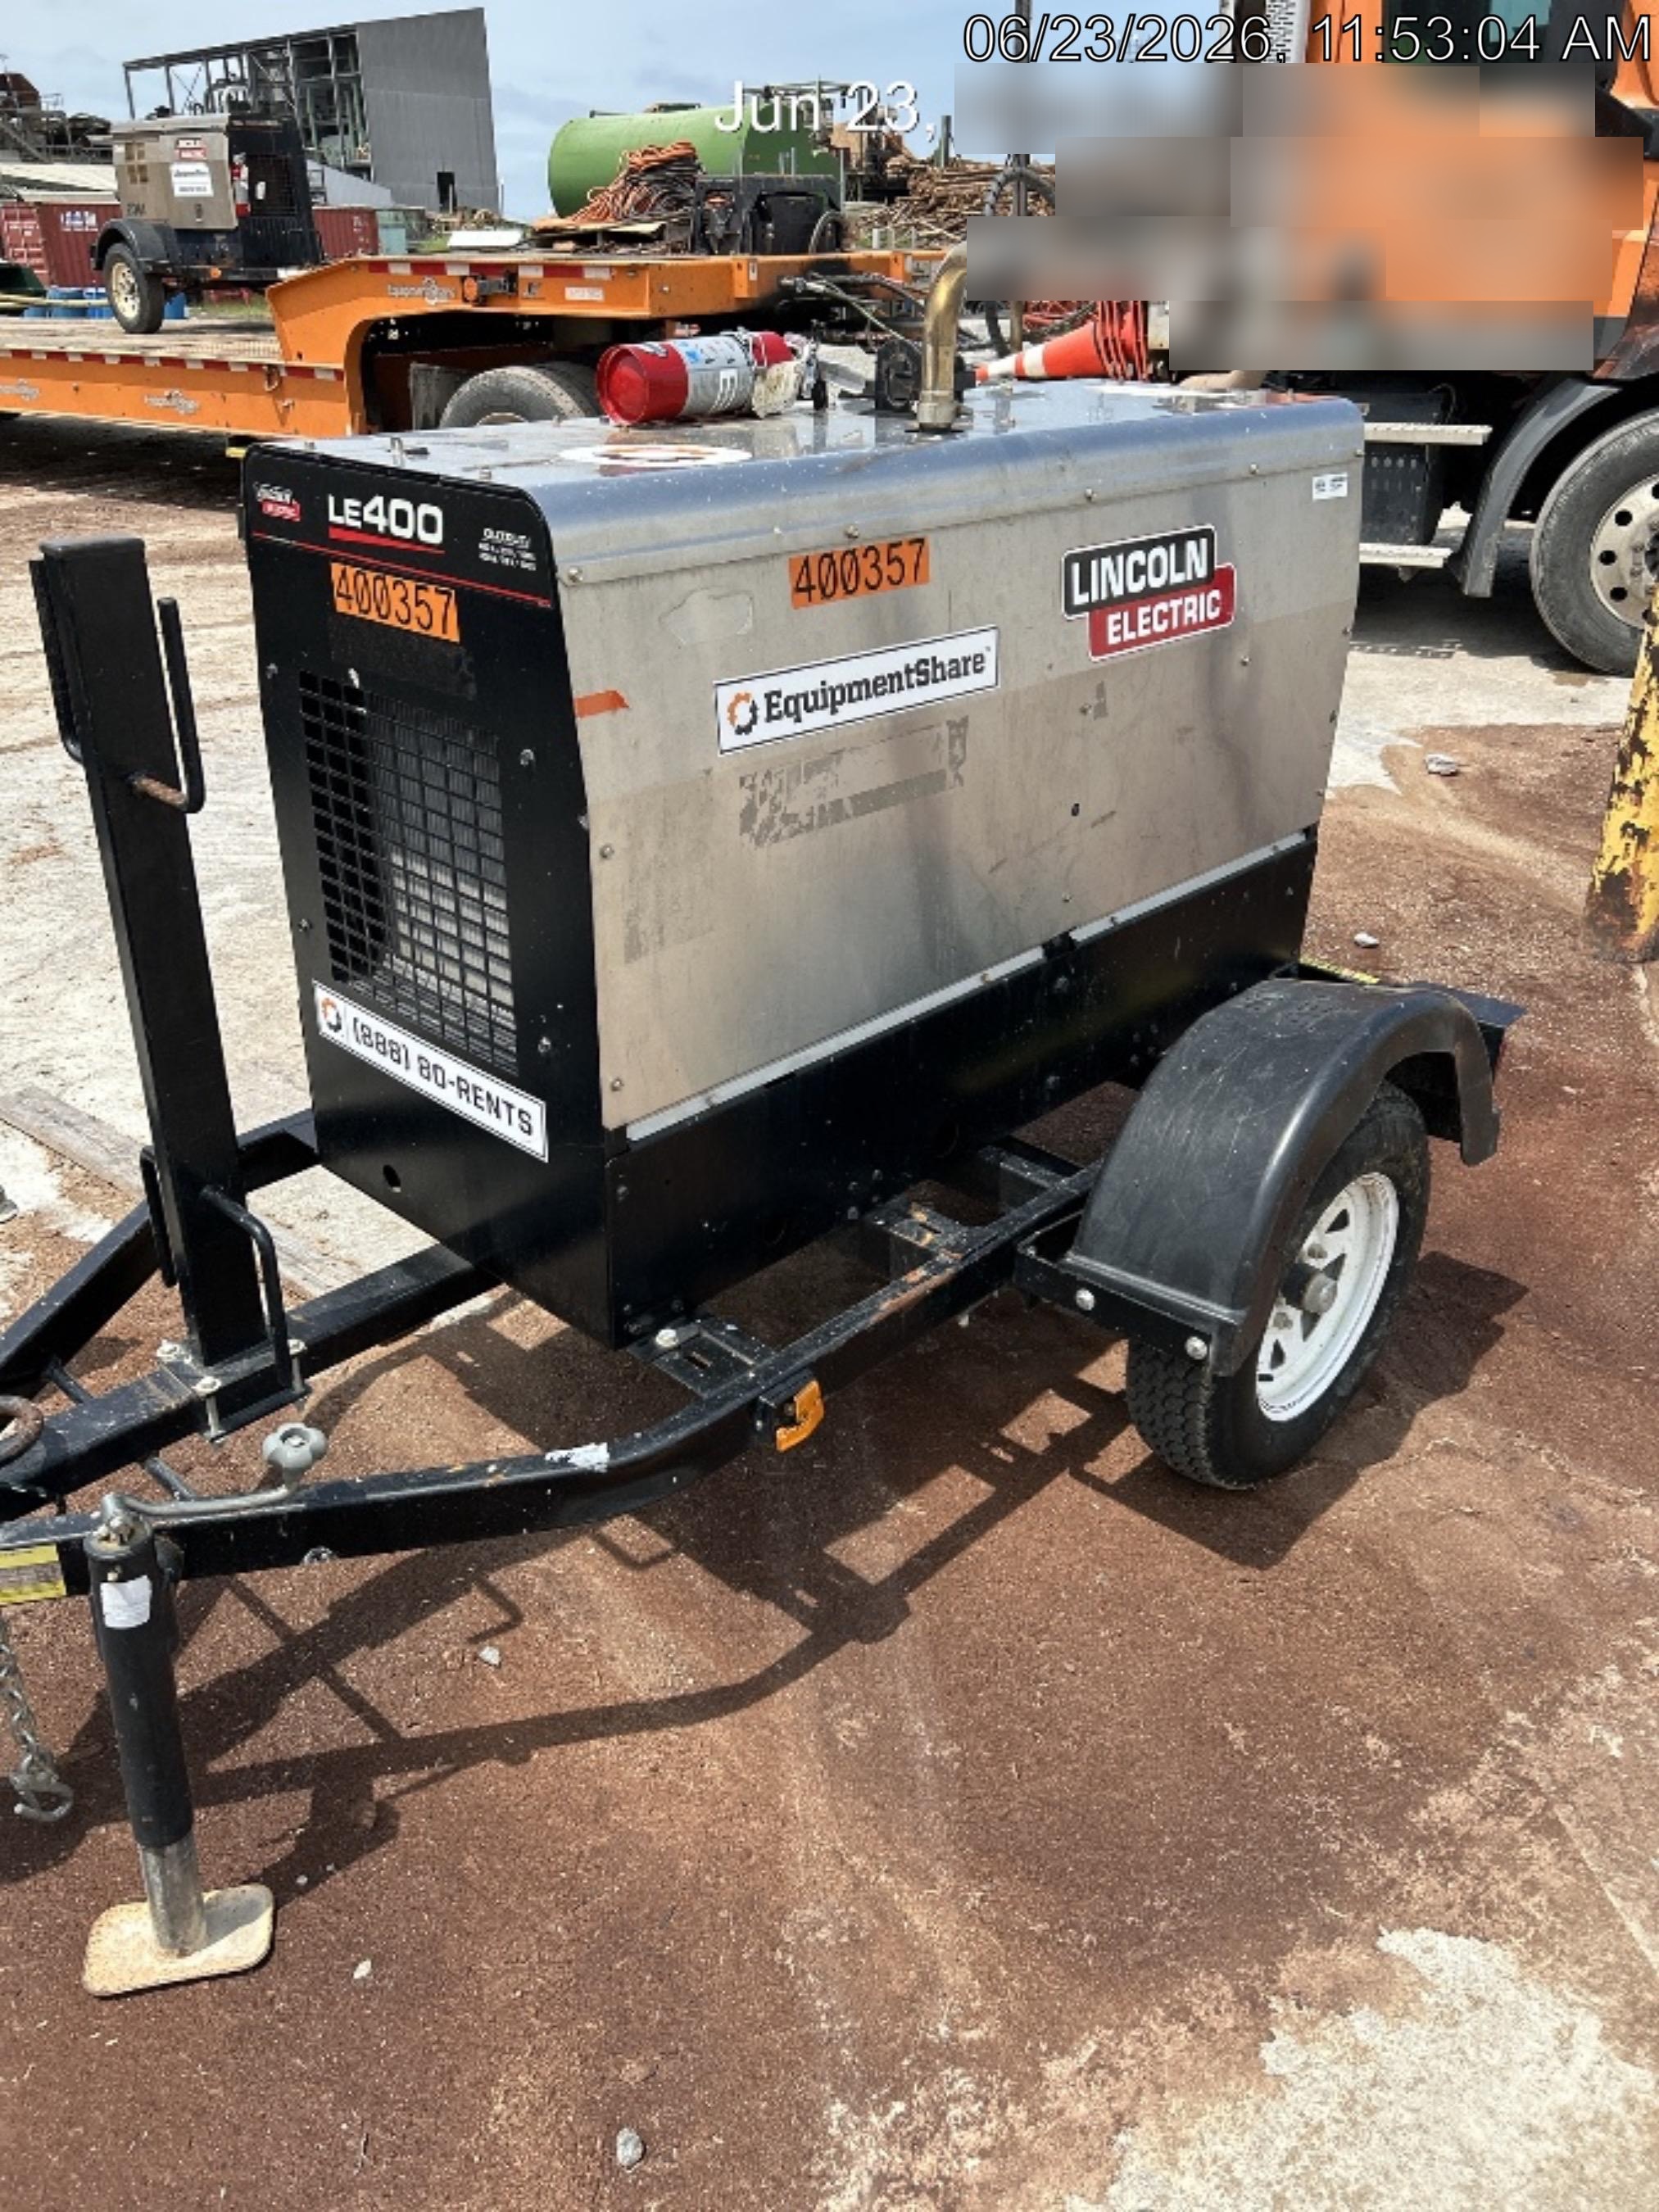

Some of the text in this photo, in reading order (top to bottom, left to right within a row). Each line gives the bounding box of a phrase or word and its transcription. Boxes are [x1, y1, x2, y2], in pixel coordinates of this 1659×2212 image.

[328, 493, 443, 545] LE400
[336, 566, 453, 635] 400357
[795, 537, 925, 603] 400357
[1072, 537, 1208, 606] LINCOLN
[1107, 589, 1222, 646] ELECTRIC
[764, 653, 985, 723] EquipmentShare
[352, 1017, 410, 1071] (888)
